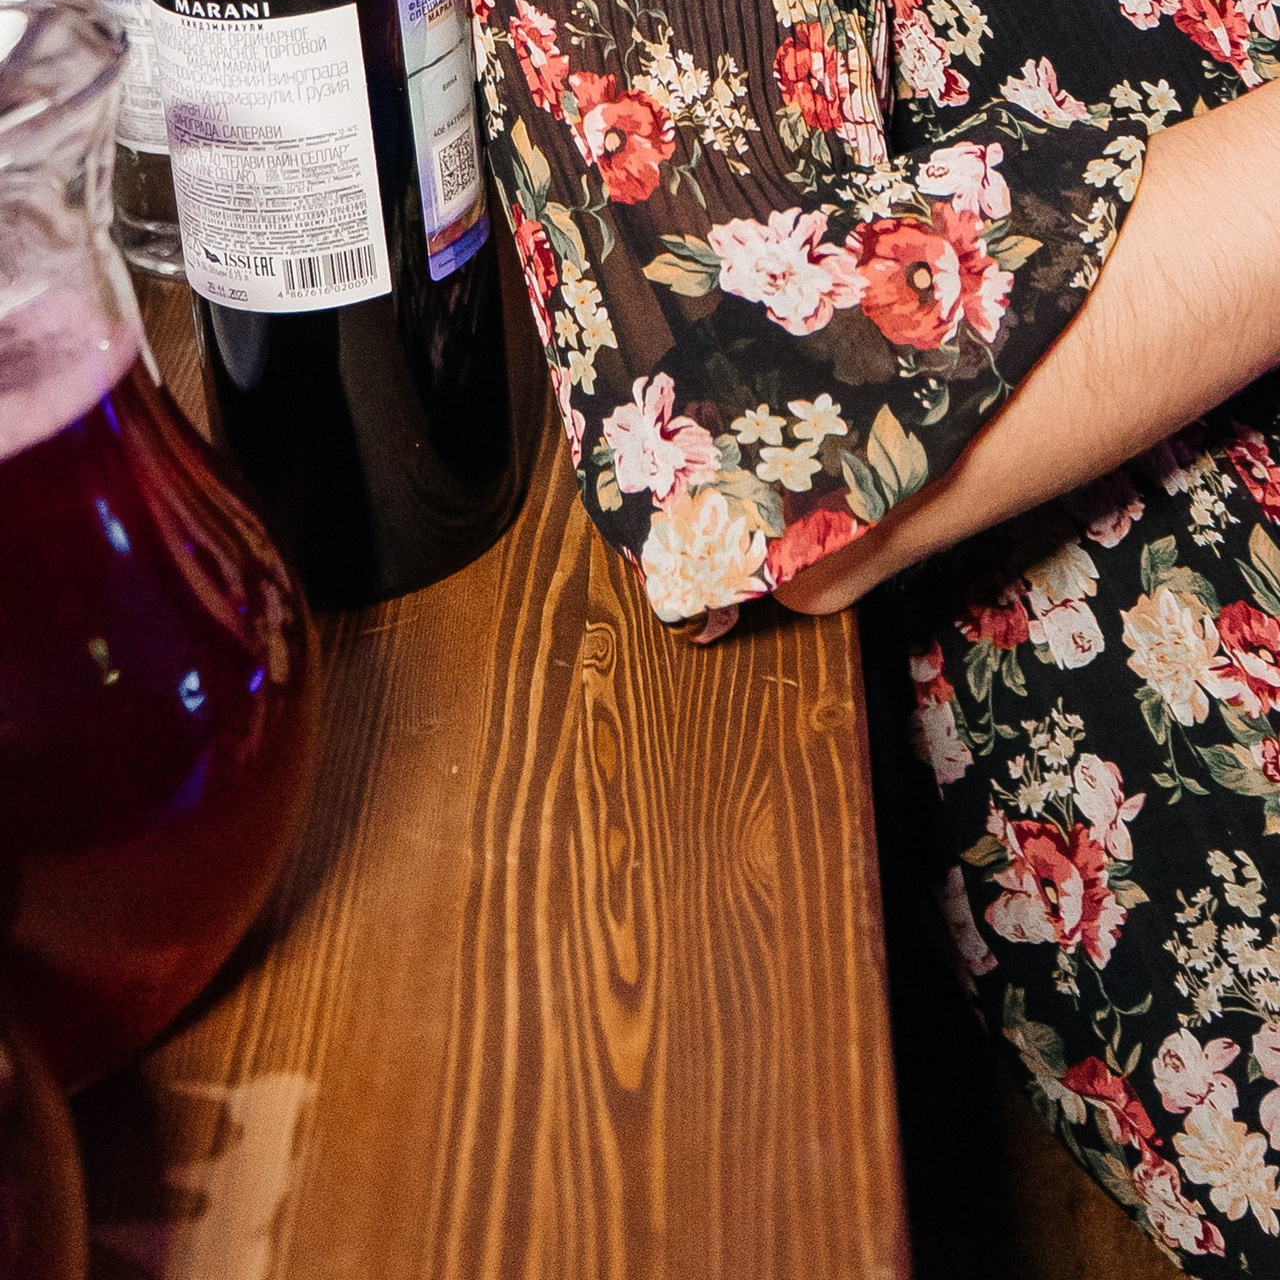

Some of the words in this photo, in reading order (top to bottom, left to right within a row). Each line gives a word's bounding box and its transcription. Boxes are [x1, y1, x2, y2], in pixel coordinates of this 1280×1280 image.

[264, 36, 327, 59] ТОРГОВОЙ
[268, 61, 349, 88] винограда
[267, 150, 299, 170] ВАЙН
